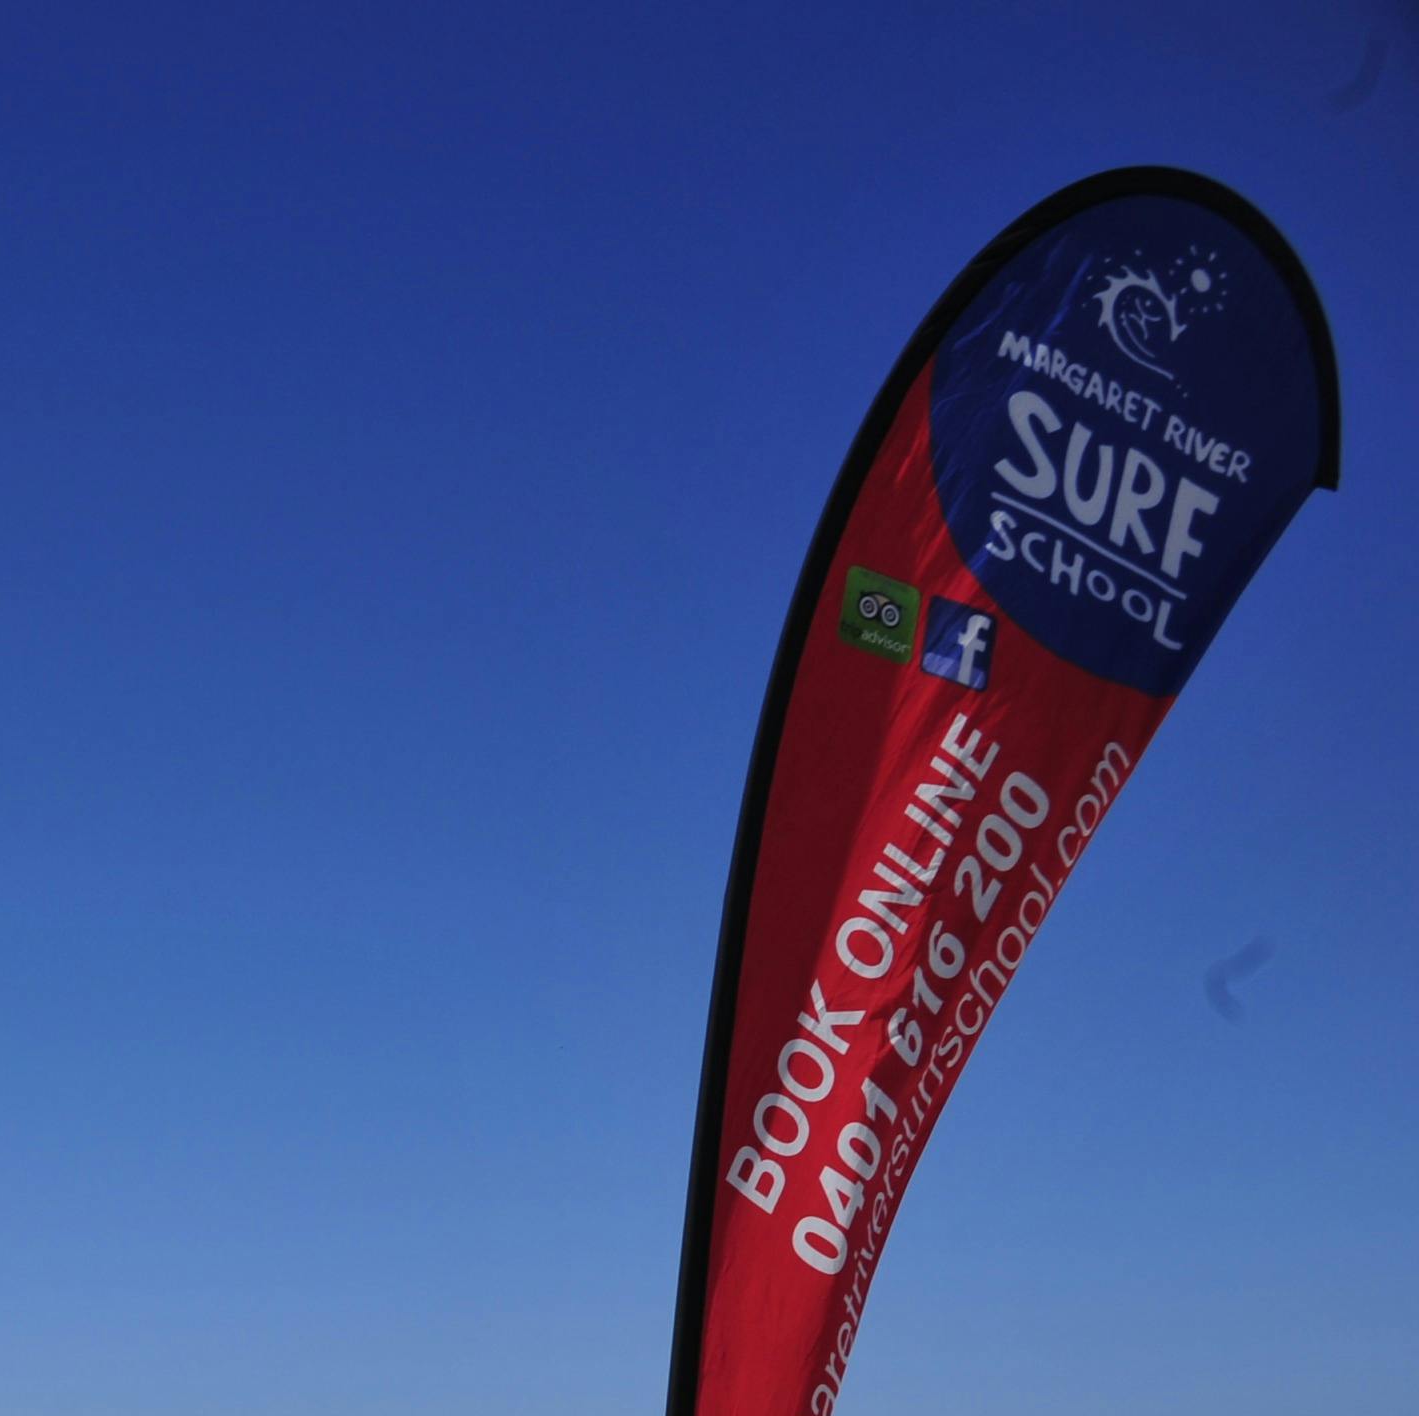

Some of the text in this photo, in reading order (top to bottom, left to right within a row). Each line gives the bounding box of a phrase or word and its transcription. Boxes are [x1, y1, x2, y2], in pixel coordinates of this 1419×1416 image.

[994, 391, 1220, 580] SURF
[998, 330, 1251, 484] MARGARET RIVER
[985, 510, 1183, 652] SCHOOL
[725, 712, 1001, 1215] BOOK ONLINE
[791, 771, 1050, 1276] 0401 616 200
